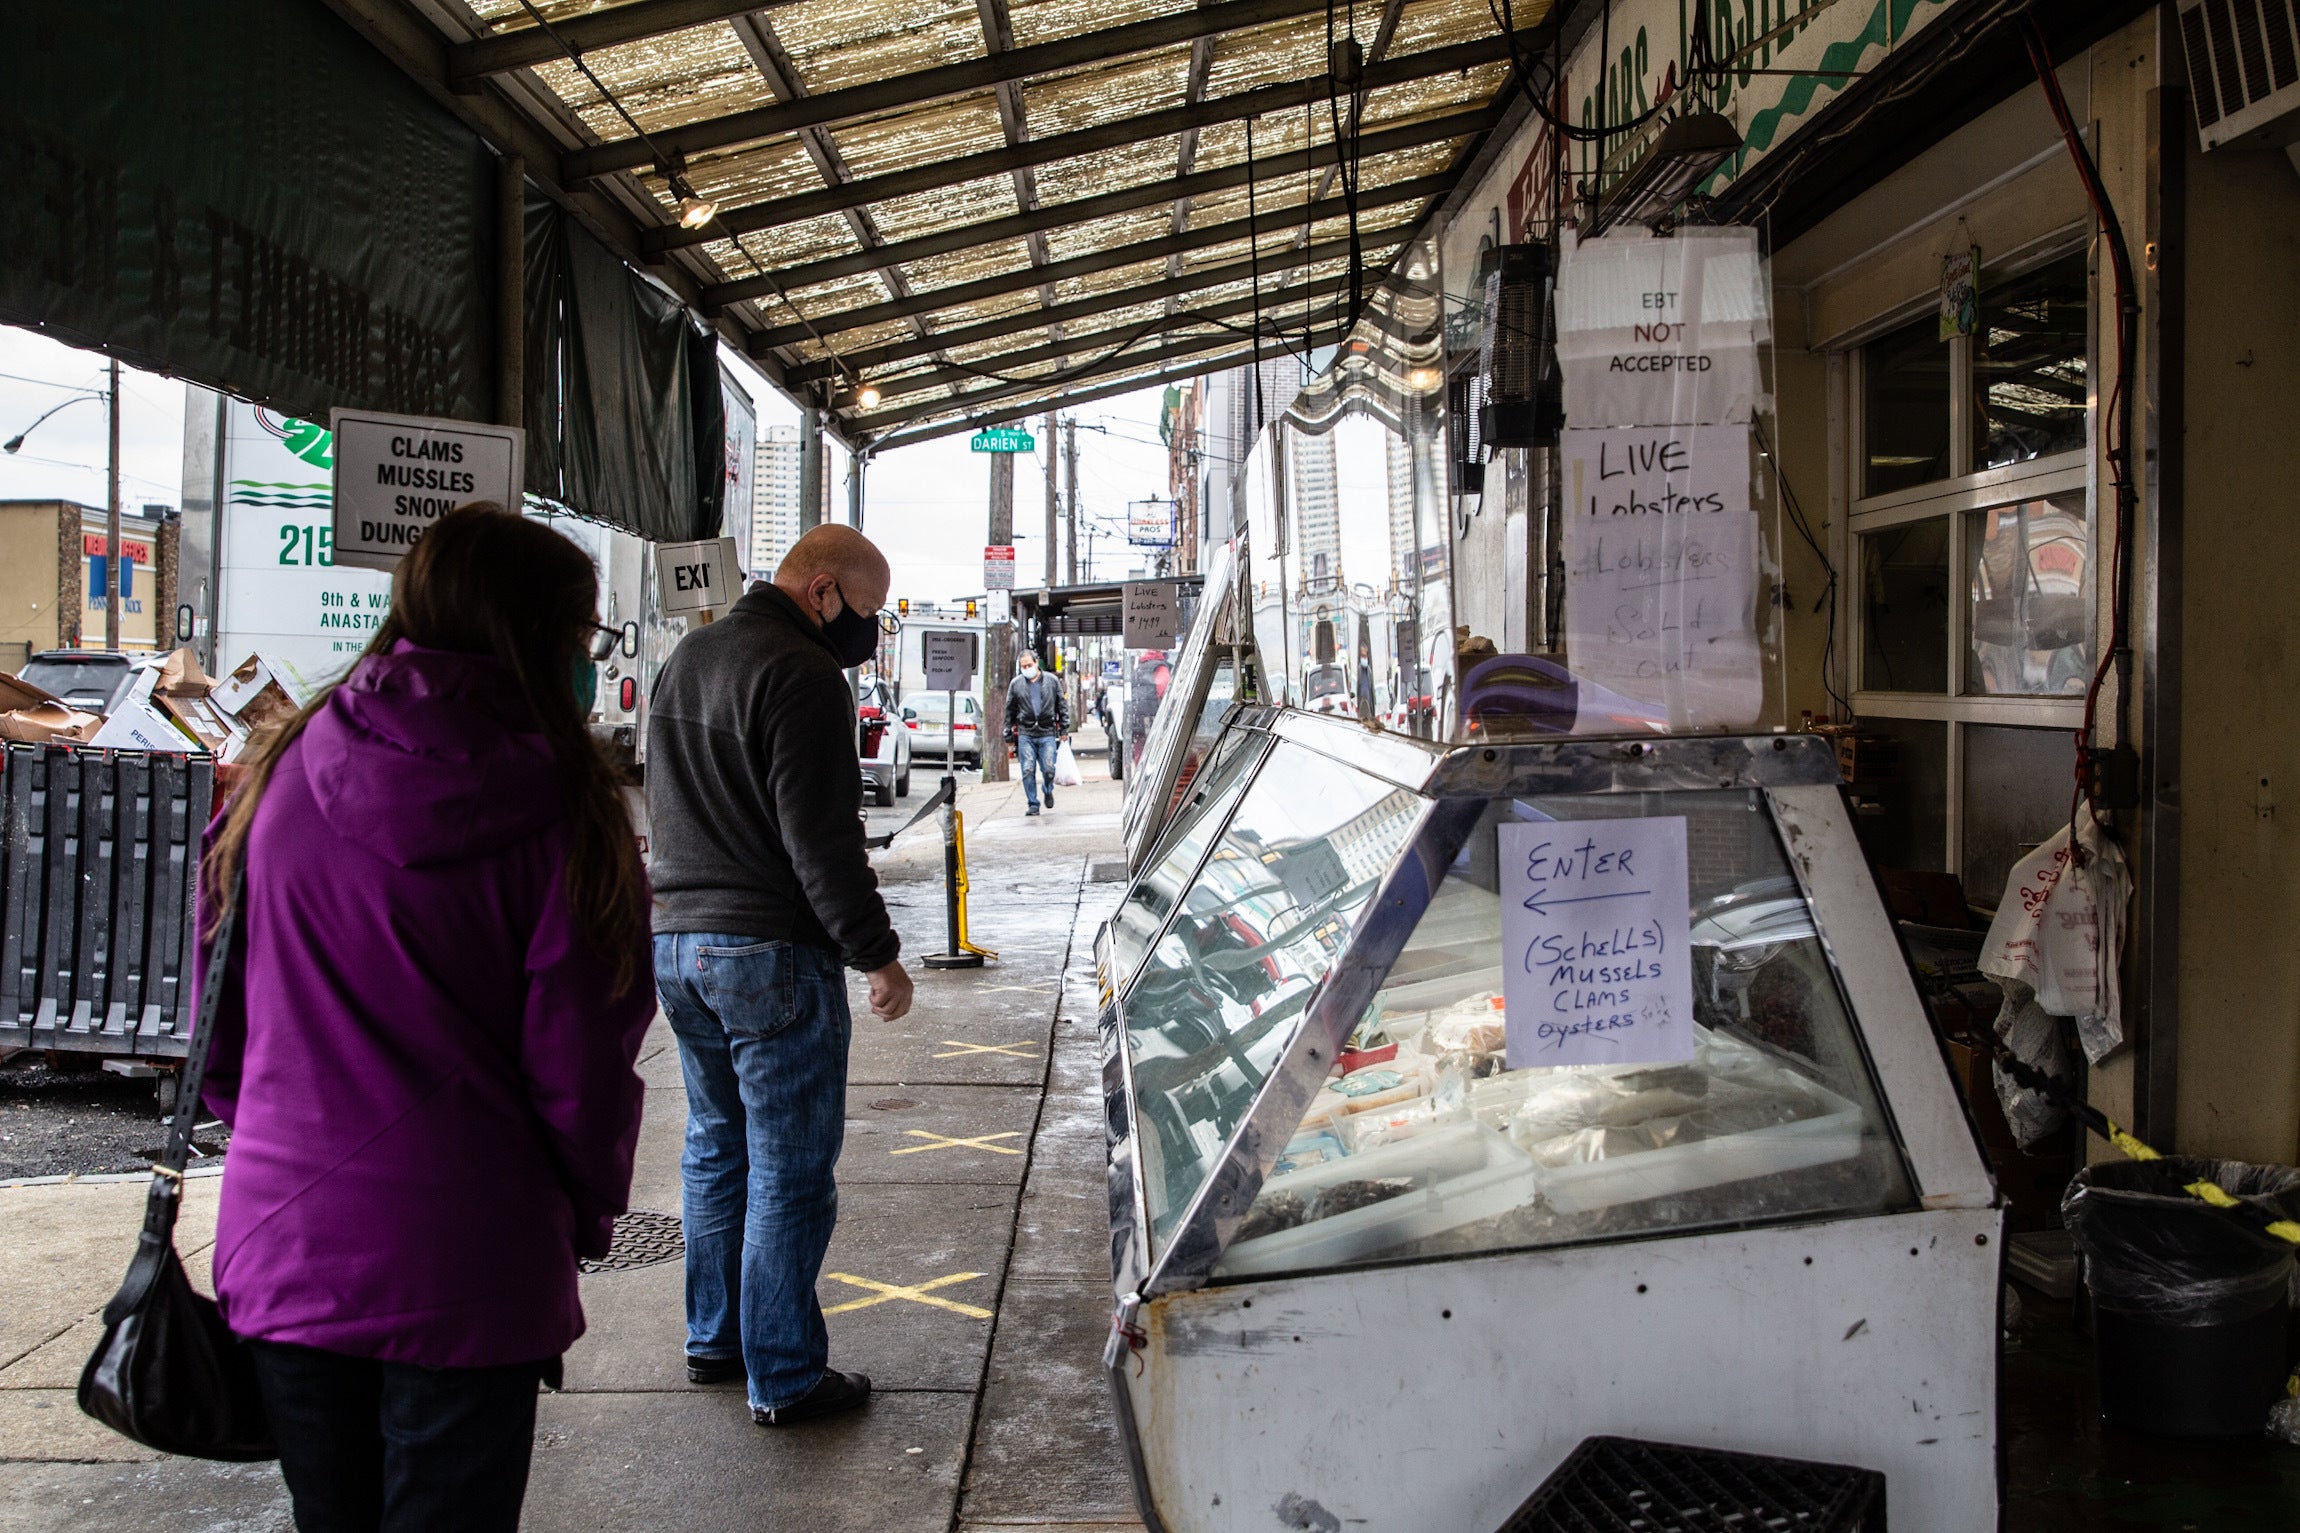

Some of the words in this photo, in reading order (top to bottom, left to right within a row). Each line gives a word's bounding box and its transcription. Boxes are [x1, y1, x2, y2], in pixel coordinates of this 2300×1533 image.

[1642, 292, 1678, 309] EBT
[1634, 322, 1686, 343] NOT
[1609, 355, 1712, 373] ACCEPTED
[391, 436, 463, 463] CLAMS
[973, 437, 1018, 450] DARIEN
[1022, 441, 1032, 450] ST
[1600, 440, 1690, 481] LIVE
[377, 463, 474, 493] MUSSLES
[361, 520, 428, 546] DUNG
[279, 524, 334, 567] 215
[321, 591, 343, 607] 9th
[350, 592, 360, 608] &
[1135, 587, 1158, 596] LIVE
[333, 641, 343, 651] IN
[345, 642, 363, 653] THE
[1553, 989, 1630, 1013] CLAMS
